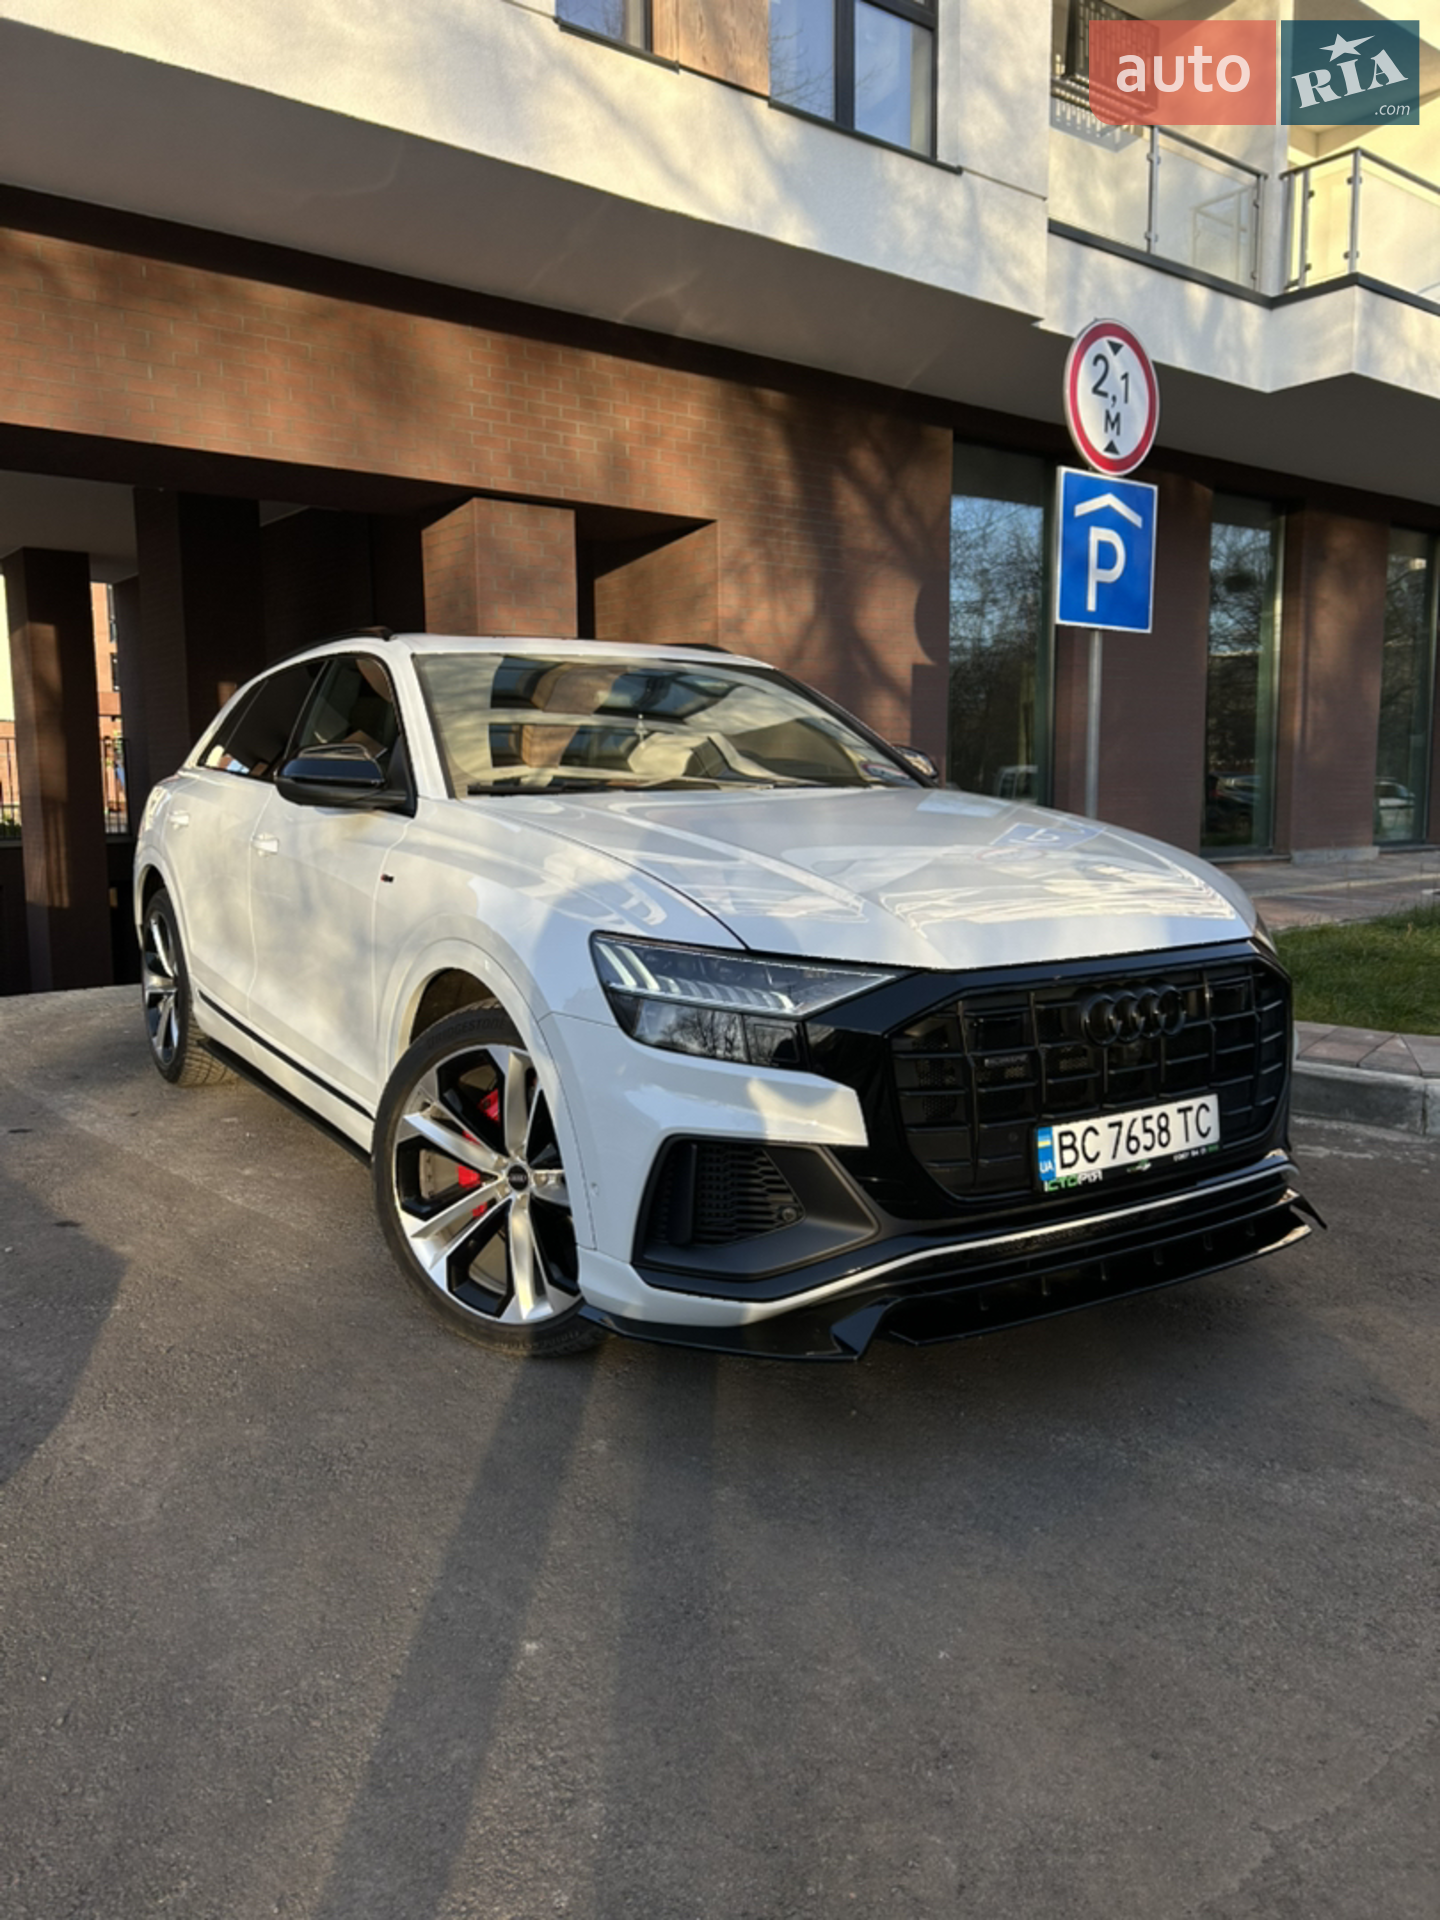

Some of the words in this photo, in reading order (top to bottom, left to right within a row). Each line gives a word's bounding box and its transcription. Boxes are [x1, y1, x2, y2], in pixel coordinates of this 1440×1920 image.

[1091, 353, 1130, 408] 2,1
[1086, 525, 1127, 613] P
[1039, 1160, 1054, 1173] UA
[1058, 1126, 1101, 1170] BC
[1108, 1111, 1172, 1160] 7658
[1177, 1103, 1212, 1144] TC
